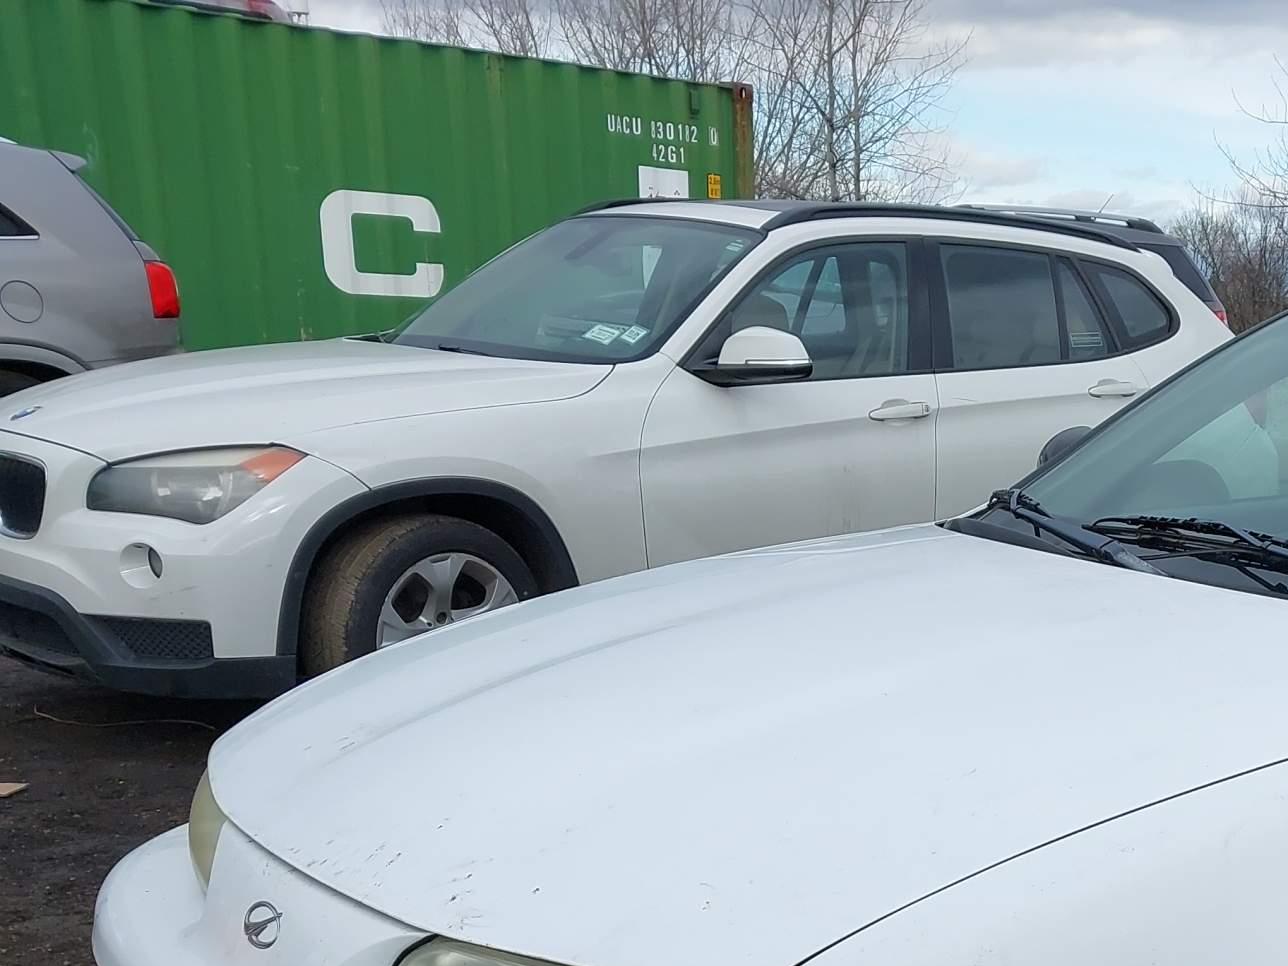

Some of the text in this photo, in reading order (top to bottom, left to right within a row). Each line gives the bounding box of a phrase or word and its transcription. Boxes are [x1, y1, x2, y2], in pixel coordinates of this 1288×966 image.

[607, 113, 641, 135] UACU
[651, 120, 698, 143] 830182
[652, 143, 685, 164] 42G1
[319, 189, 444, 298] C
